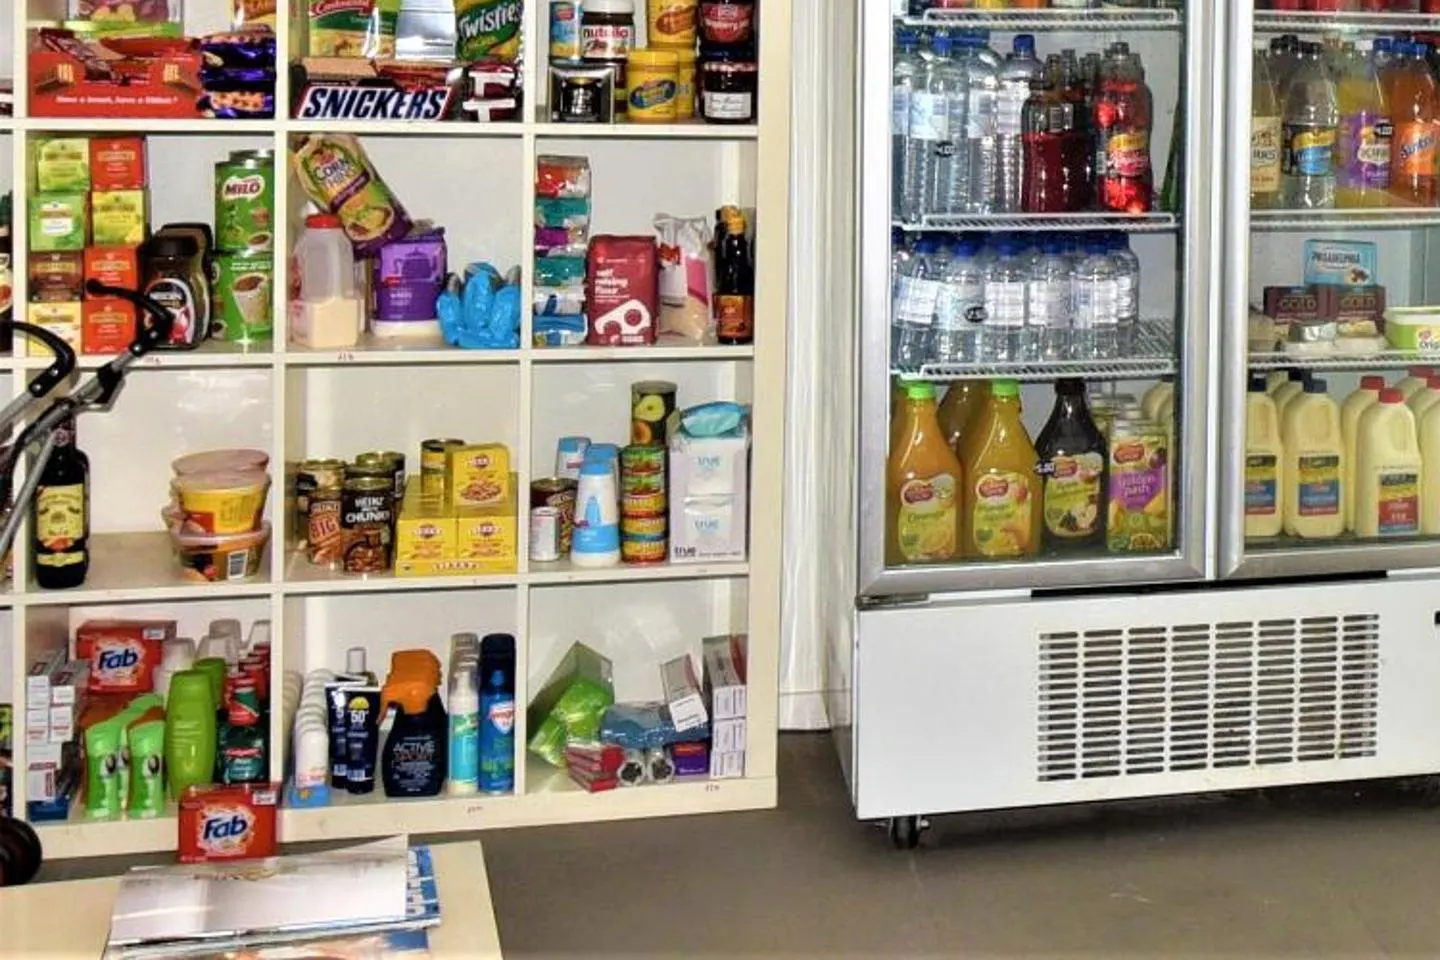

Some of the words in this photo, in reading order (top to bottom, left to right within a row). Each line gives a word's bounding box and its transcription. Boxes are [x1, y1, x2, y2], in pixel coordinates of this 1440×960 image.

[303, 88, 449, 120] SNICKERS
[99, 647, 138, 670] Fab
[203, 814, 248, 840] Fab
